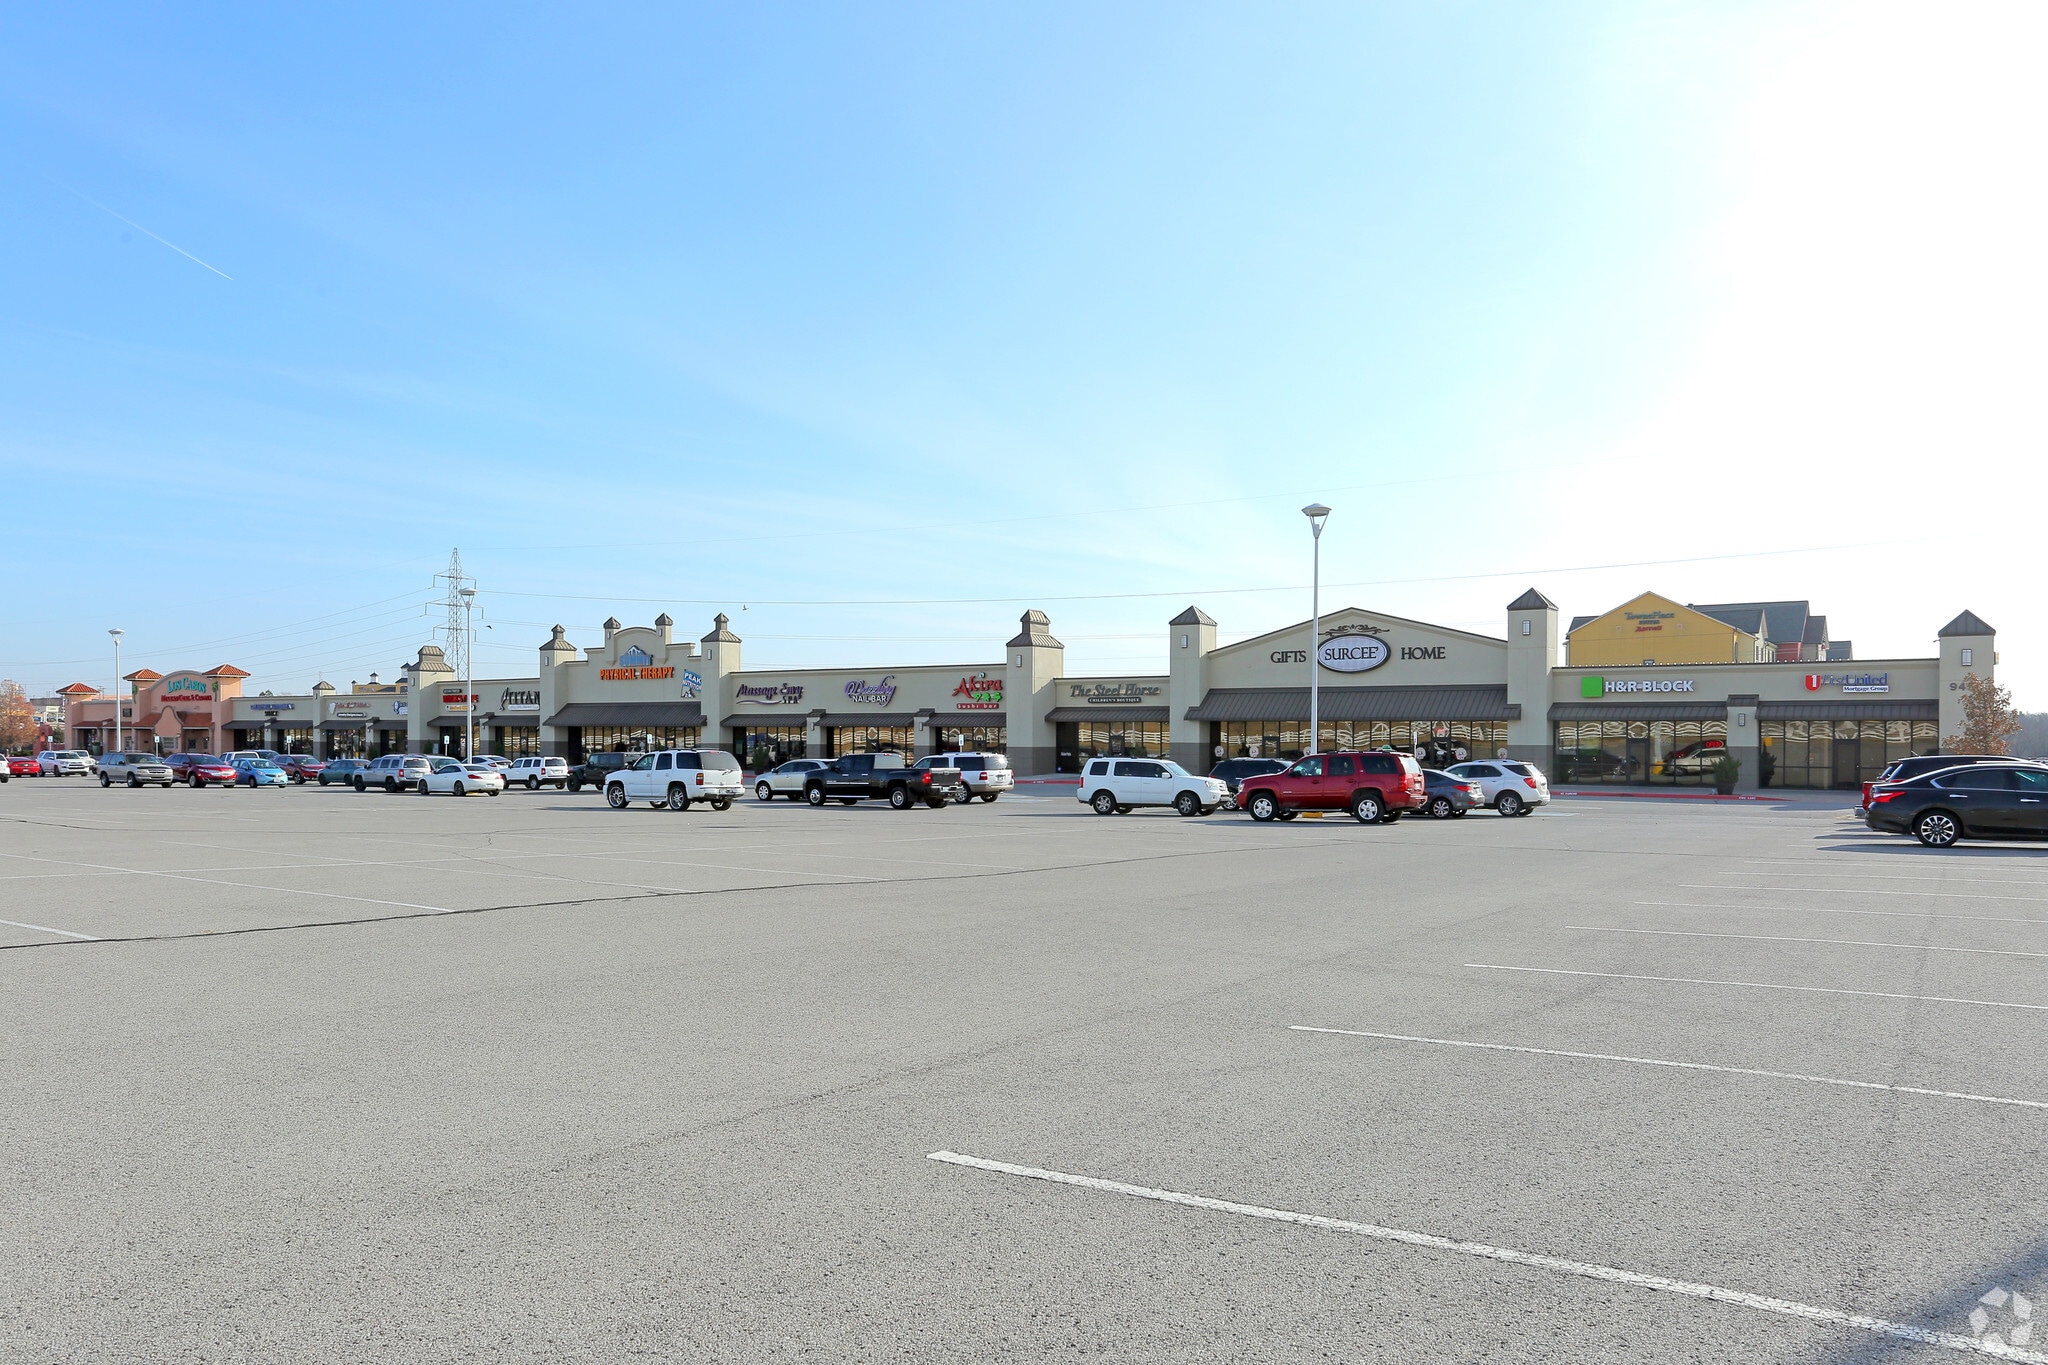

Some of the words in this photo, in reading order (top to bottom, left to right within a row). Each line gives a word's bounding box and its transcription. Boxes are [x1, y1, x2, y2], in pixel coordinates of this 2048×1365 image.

[1270, 651, 1307, 663] GIFTS
[1401, 647, 1446, 660] HOME
[600, 668, 637, 680] PHYSICAL
[639, 667, 675, 679] THERAPY
[684, 672, 702, 684] PEAK
[736, 684, 778, 700] Massage
[952, 672, 1003, 699] Akira
[1070, 684, 1092, 697] The
[1094, 684, 1122, 697] Steel
[1123, 684, 1160, 696] Horse
[1605, 681, 1638, 693] H&R
[1642, 680, 1695, 692] BLOCK
[508, 690, 540, 705] TITAN
[782, 696, 799, 704] SPA
[852, 695, 870, 703] NAIL
[871, 695, 888, 703] BAR
